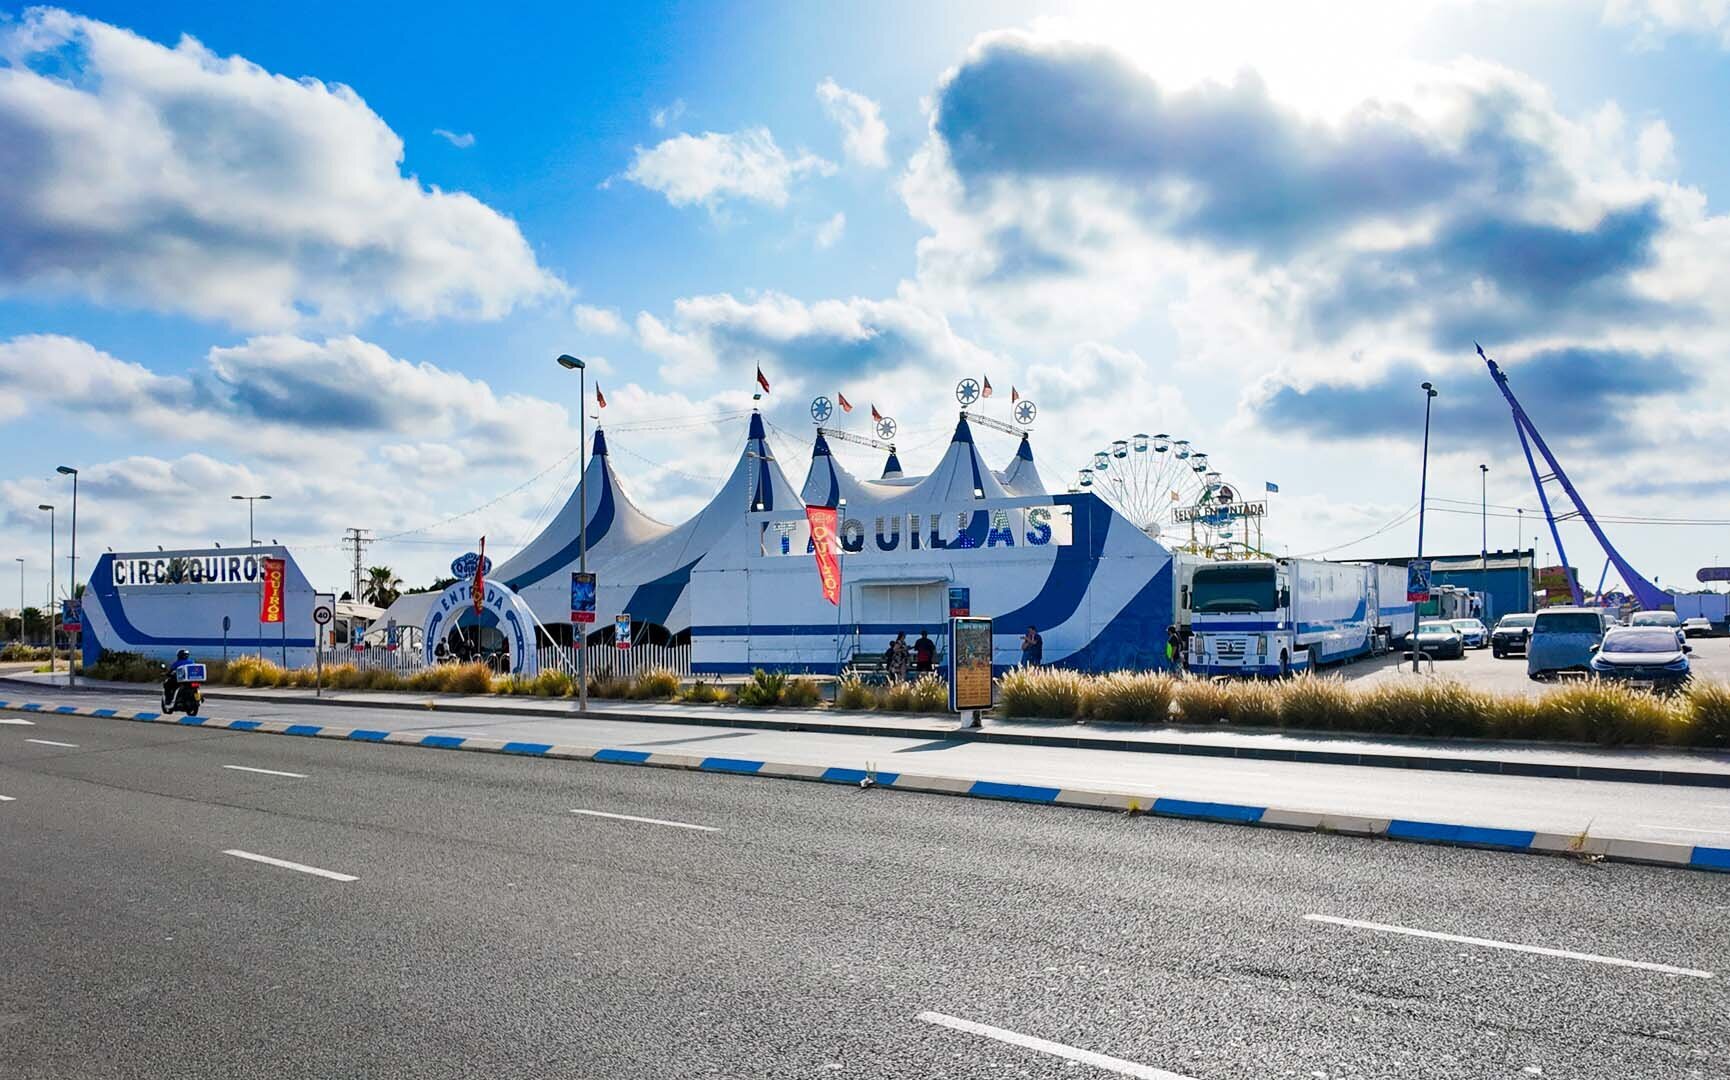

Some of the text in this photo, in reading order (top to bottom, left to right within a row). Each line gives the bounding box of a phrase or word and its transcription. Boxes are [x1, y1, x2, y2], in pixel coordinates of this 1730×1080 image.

[1204, 503, 1265, 517] ENNTADA
[774, 508, 1053, 555] TQUILLAS
[115, 558, 184, 584] CIRCO
[441, 585, 503, 611] ENTDA
[317, 611, 328, 619] 40
